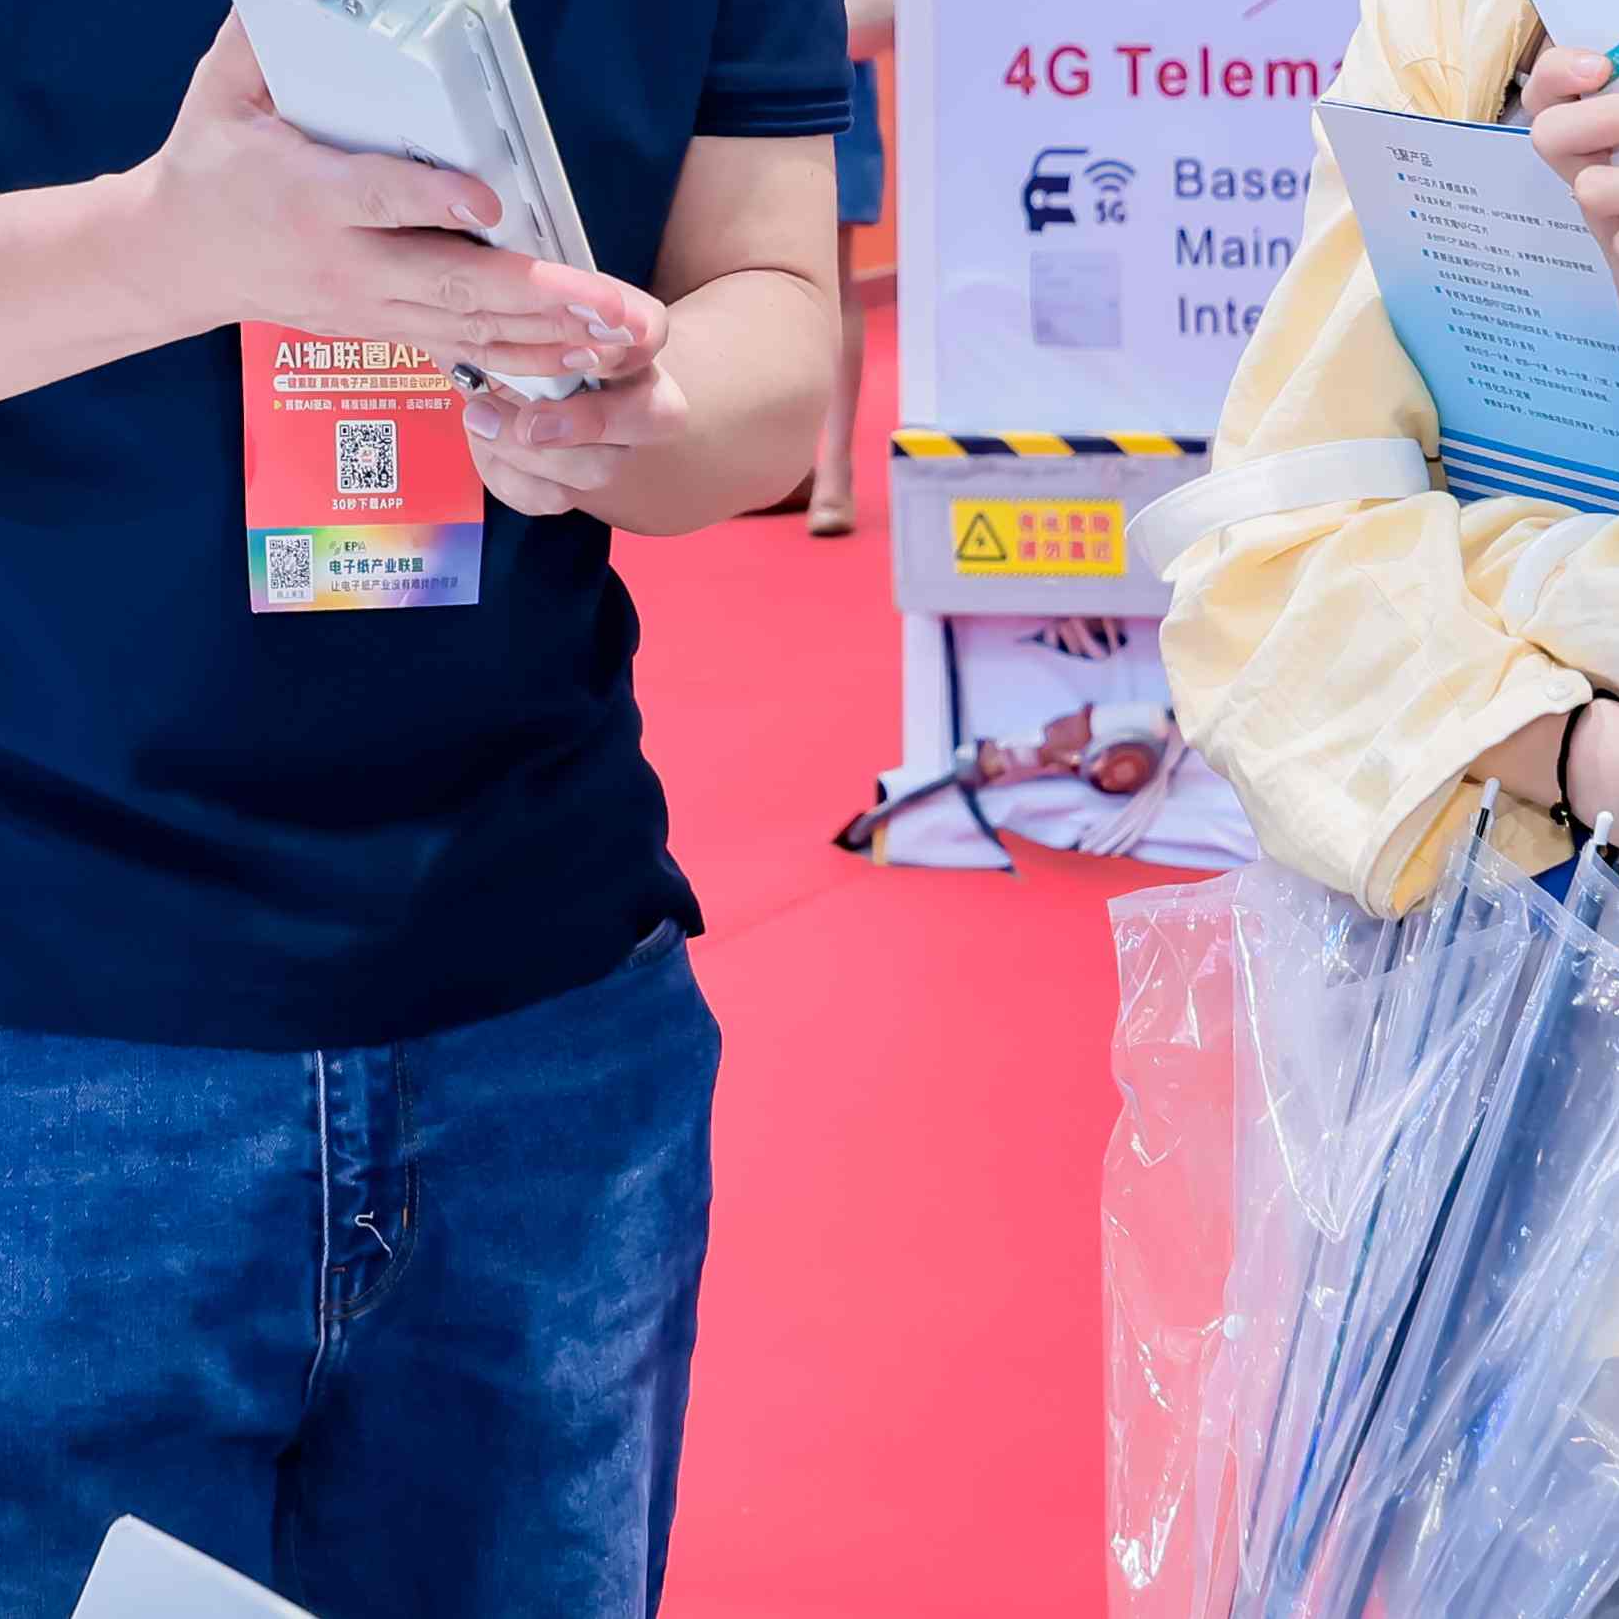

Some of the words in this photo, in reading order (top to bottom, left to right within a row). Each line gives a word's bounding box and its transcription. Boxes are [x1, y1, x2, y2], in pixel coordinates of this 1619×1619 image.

[1004, 45, 1091, 98] 4G
[1115, 44, 1343, 100] Telem
[1174, 157, 1311, 201] Base
[1176, 224, 1292, 268] Main
[274, 341, 439, 369] AI物联圈AP
